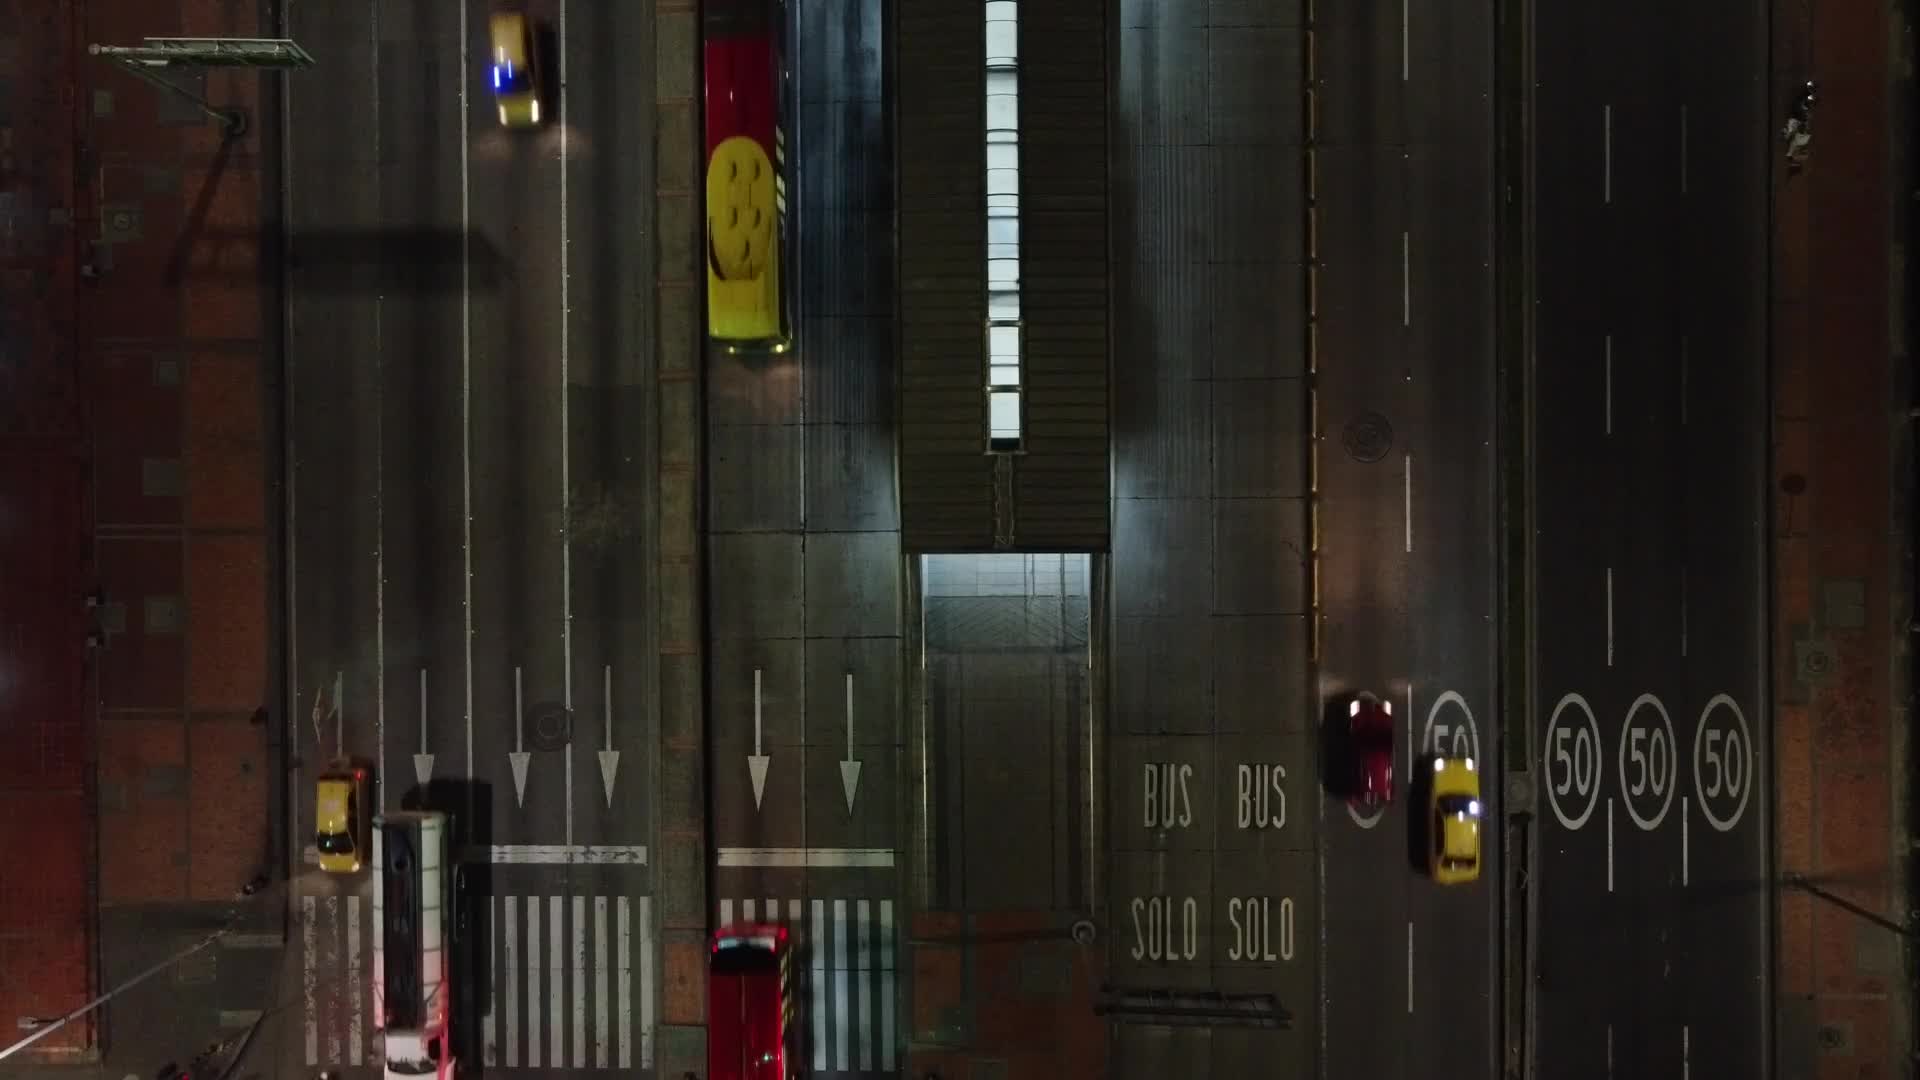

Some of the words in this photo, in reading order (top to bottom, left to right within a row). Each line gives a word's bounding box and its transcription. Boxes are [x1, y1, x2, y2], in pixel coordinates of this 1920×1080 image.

[1556, 728, 1592, 795] 50
[1631, 728, 1666, 795] 50
[1706, 729, 1741, 797] 50
[1144, 763, 1192, 828] BUS
[1238, 764, 1286, 828] BUS
[1131, 896, 1196, 960] SOLO
[1229, 897, 1293, 961] SOLO
